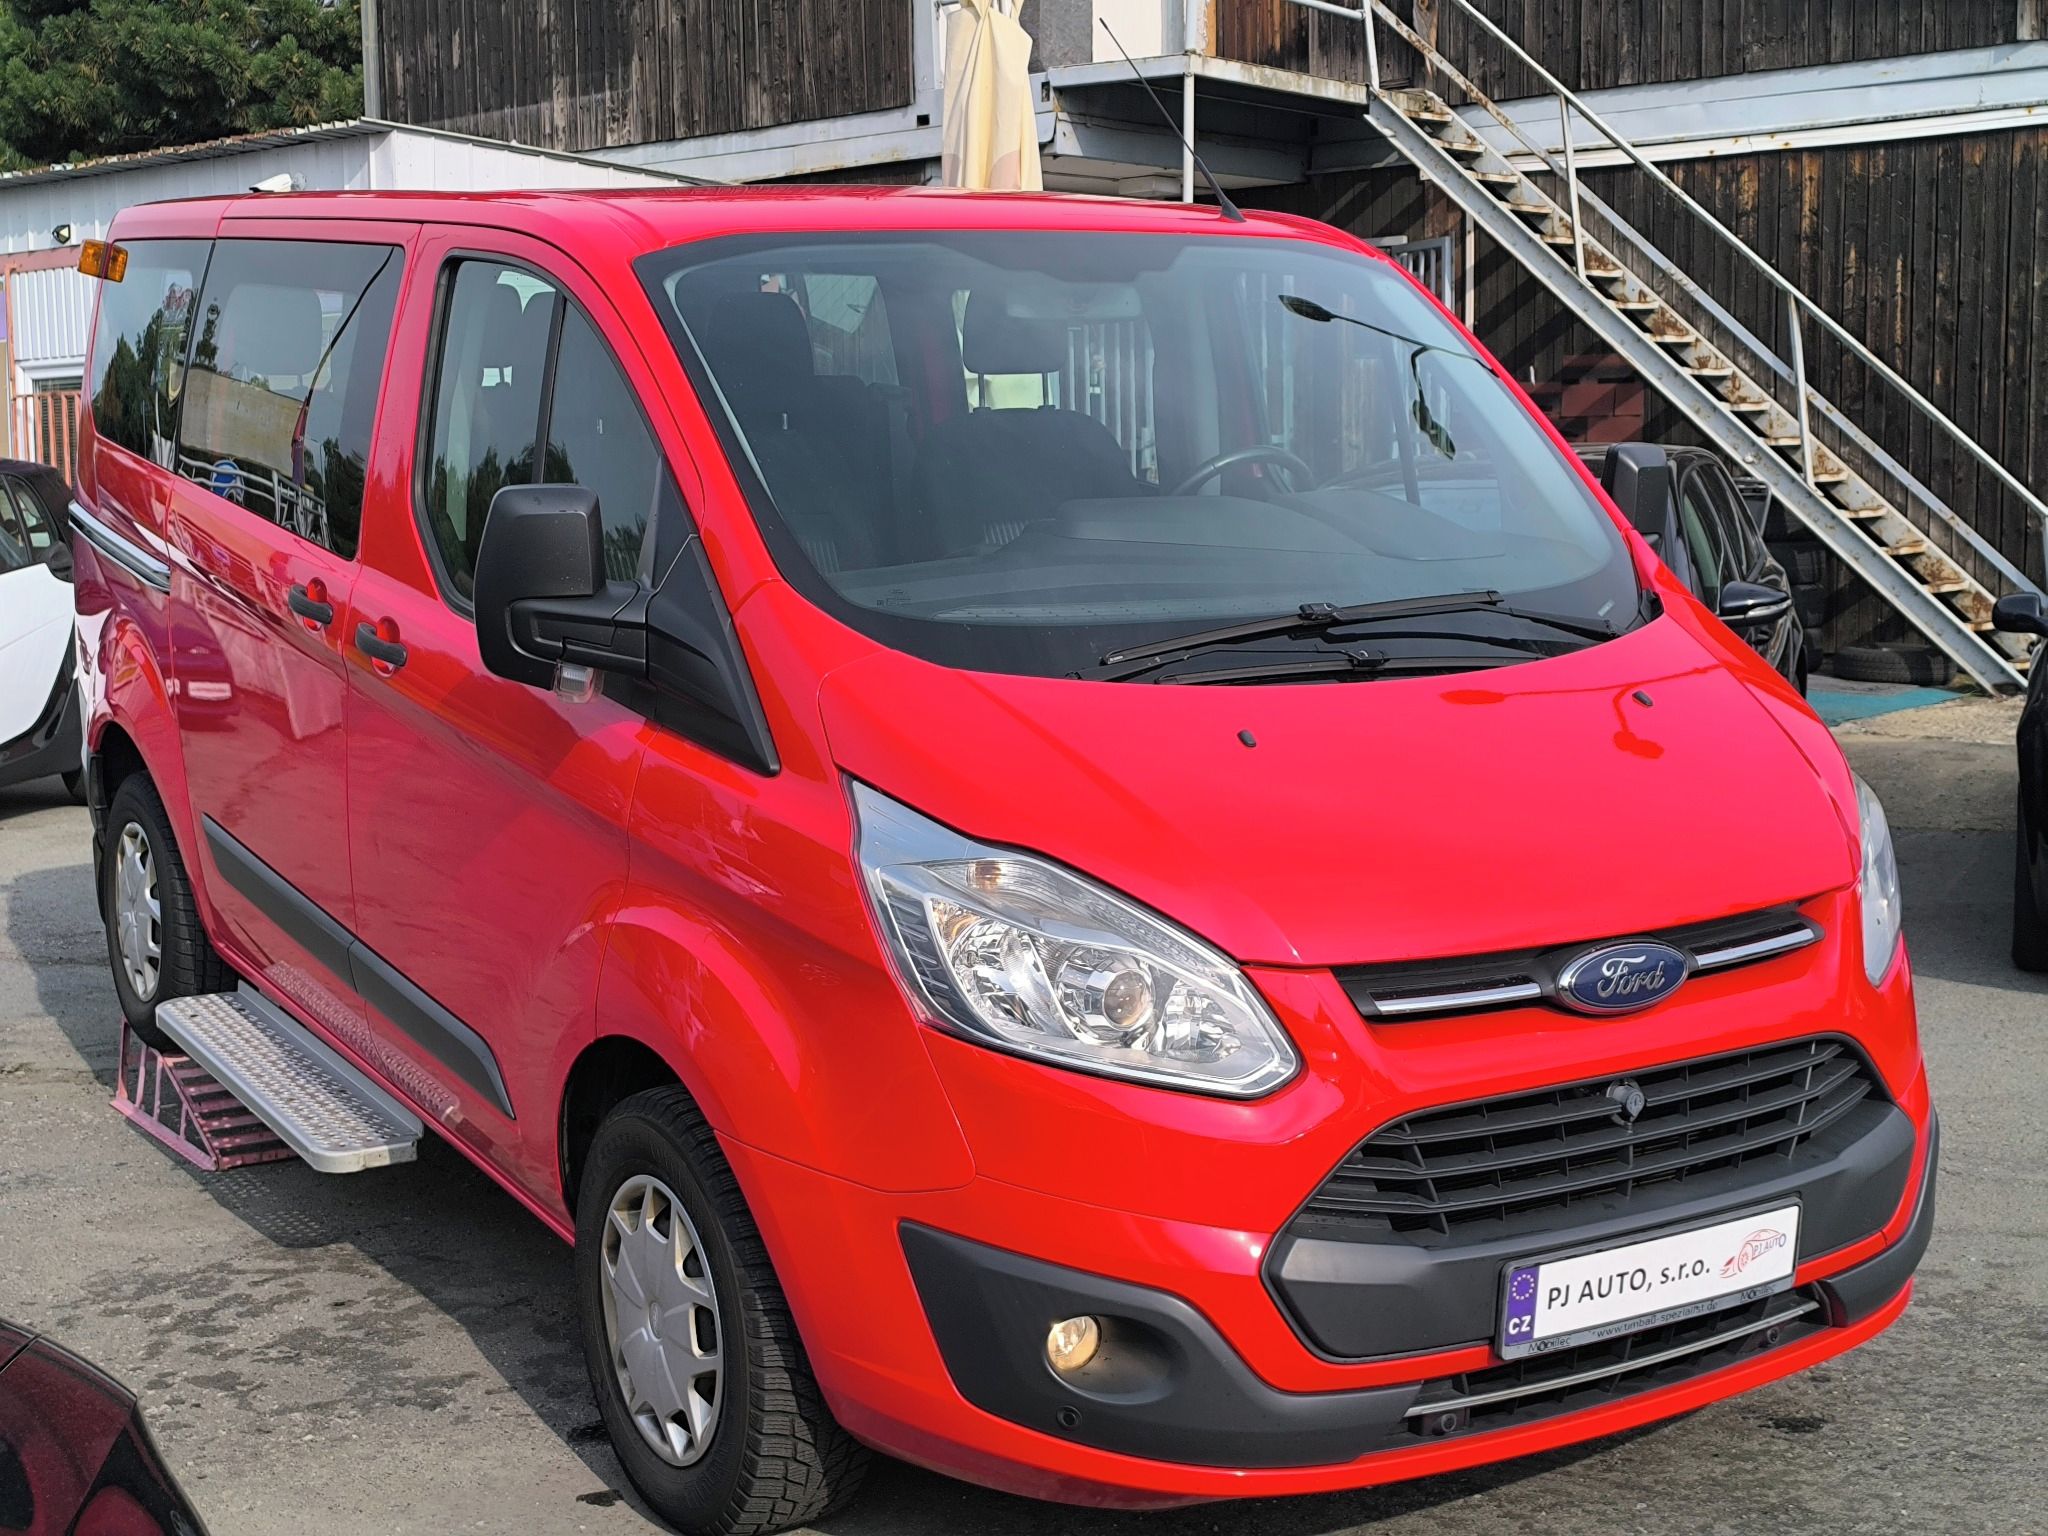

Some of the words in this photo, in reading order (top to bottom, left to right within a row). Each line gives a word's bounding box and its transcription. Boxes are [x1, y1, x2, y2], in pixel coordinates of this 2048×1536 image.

[1597, 955, 1665, 998] Ford
[1763, 1233, 1787, 1250] AUTO
[1547, 1285, 1571, 1310] PJ
[1578, 1267, 1652, 1304] AUTO,
[1659, 1258, 1711, 1285] s.r.o.
[1508, 1314, 1532, 1336] CZ
